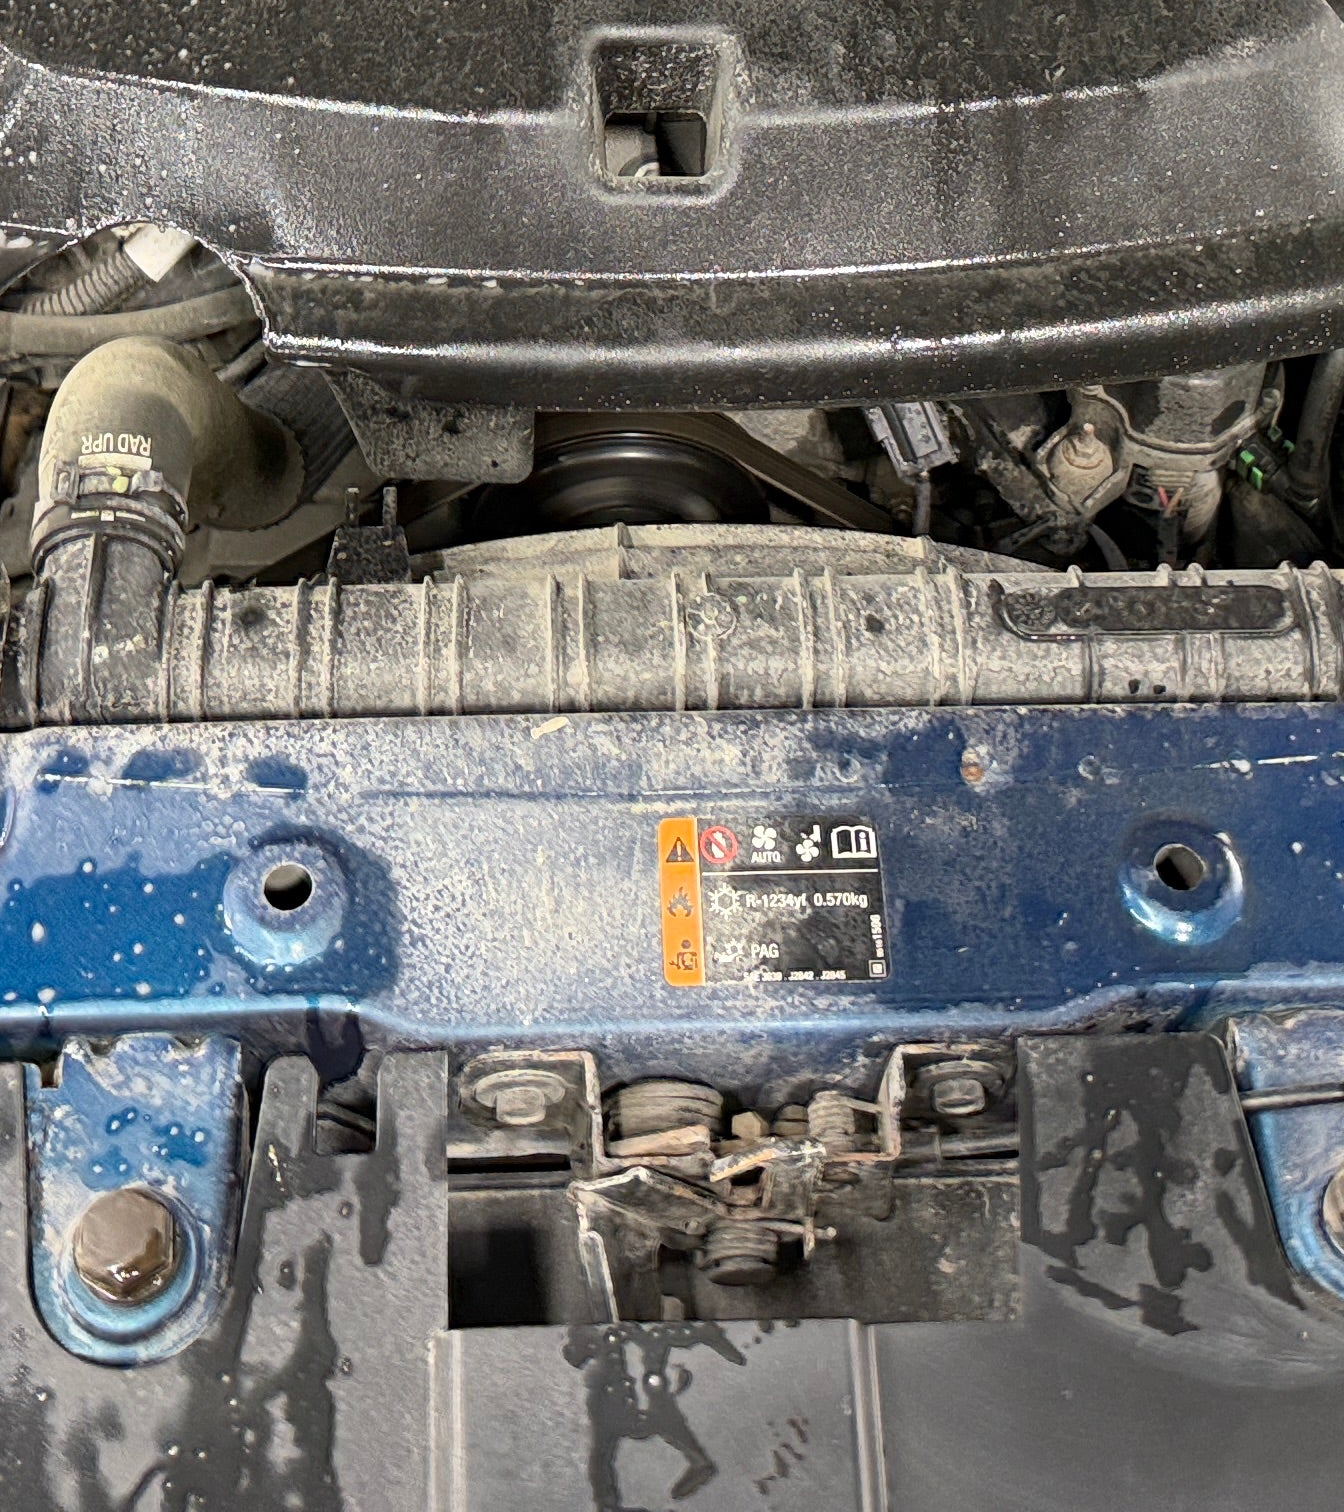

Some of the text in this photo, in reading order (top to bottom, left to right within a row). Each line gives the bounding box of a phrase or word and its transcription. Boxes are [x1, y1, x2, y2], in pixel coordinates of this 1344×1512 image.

[81, 432, 152, 457] RAD UPR
[751, 851, 781, 863] AUTO
[745, 892, 869, 909] R-1234yf 0.570kg
[751, 943, 780, 959] PAG
